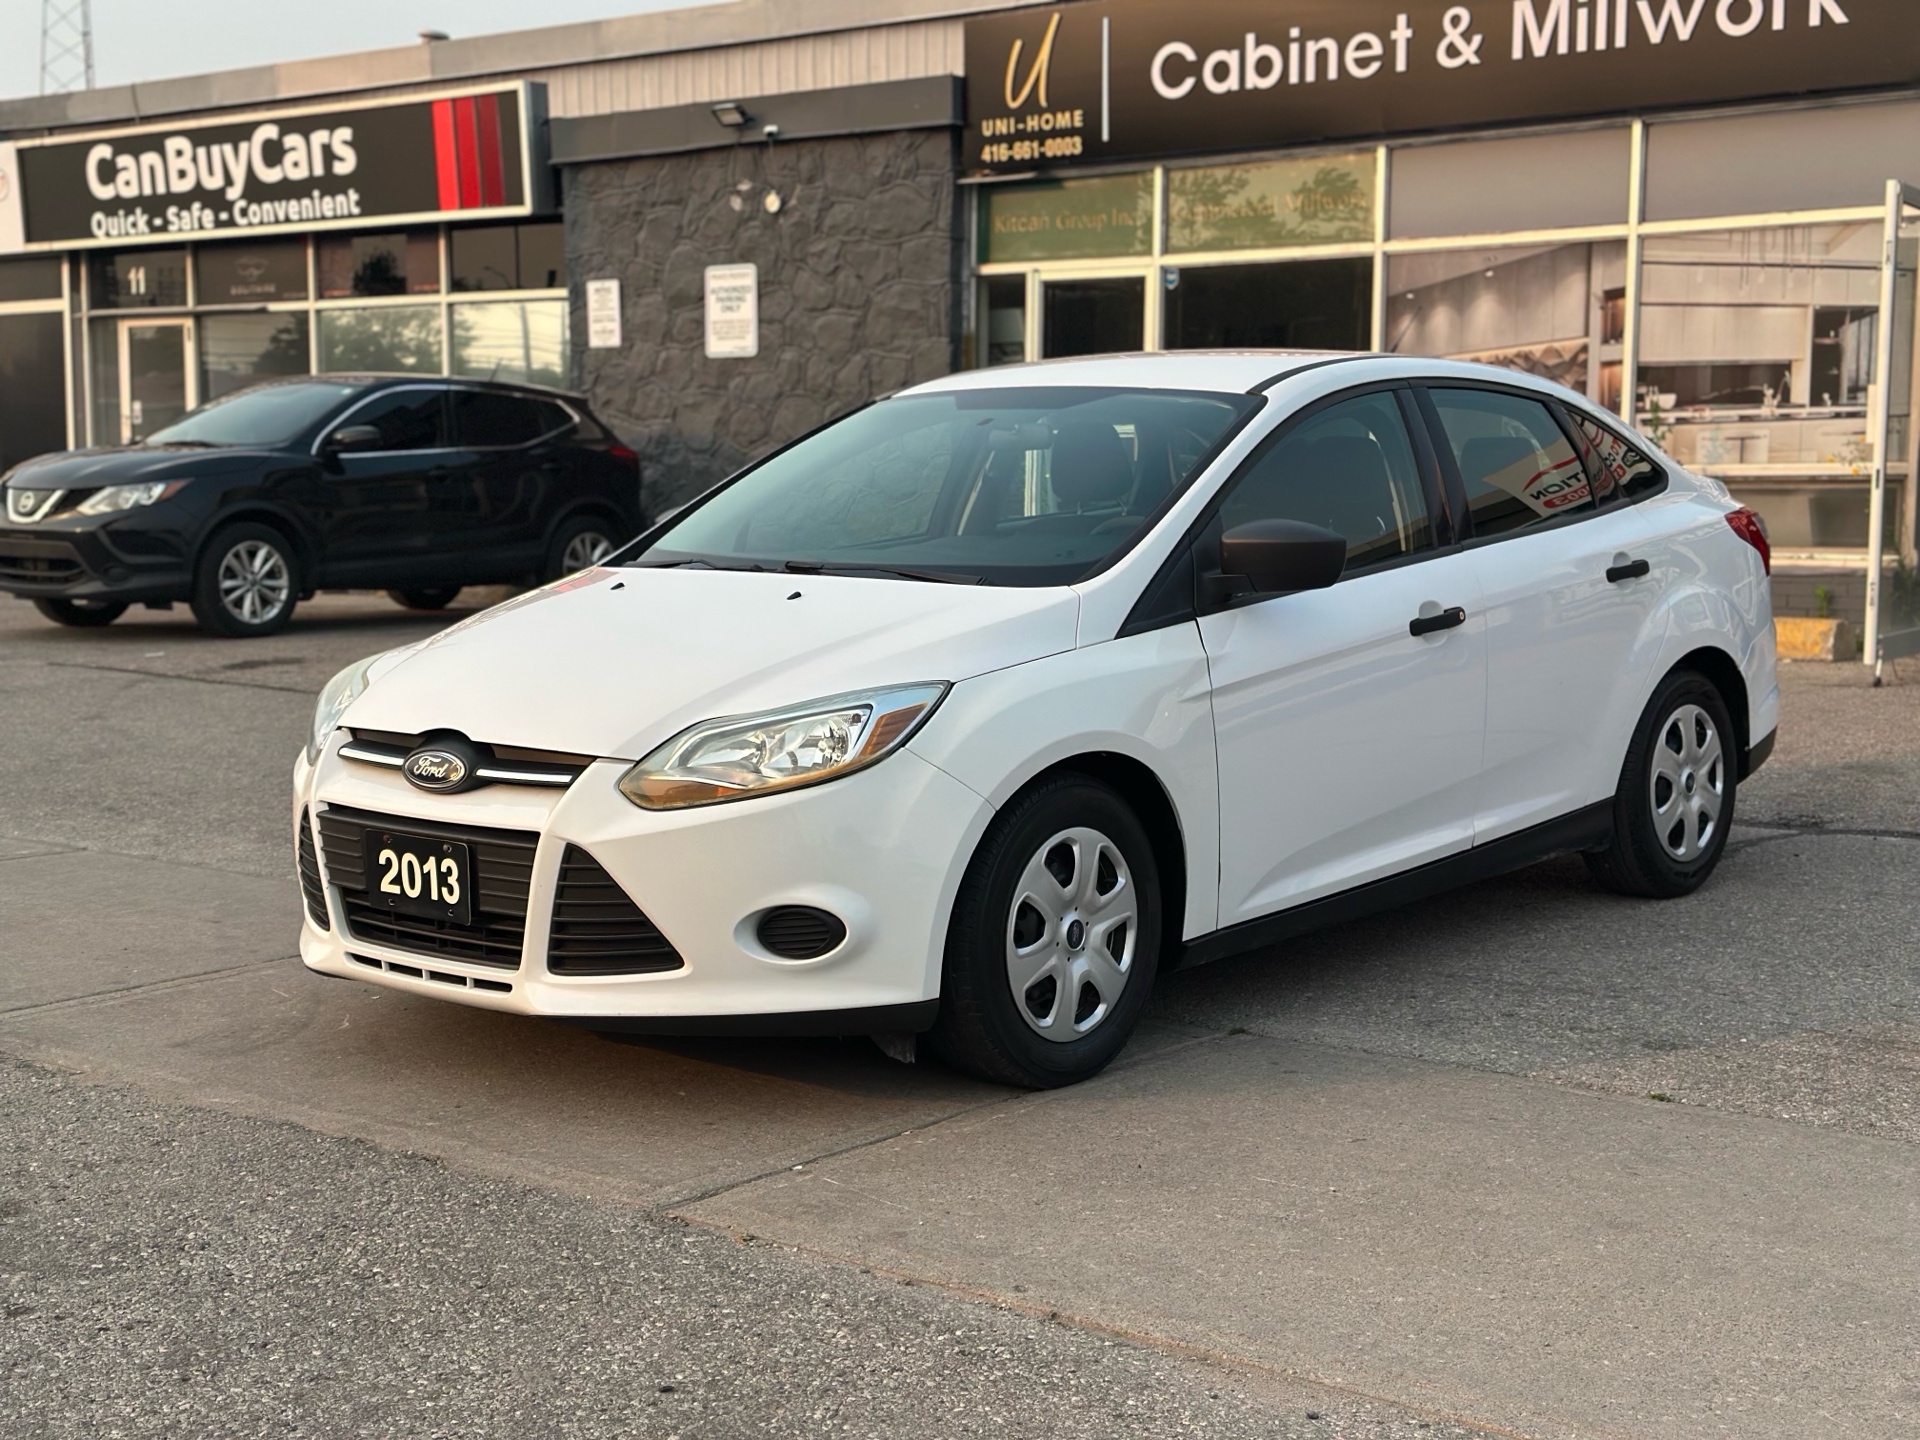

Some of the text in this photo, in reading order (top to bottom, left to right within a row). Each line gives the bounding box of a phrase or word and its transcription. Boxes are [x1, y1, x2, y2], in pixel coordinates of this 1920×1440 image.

[1150, 13, 1414, 100] Cabinet
[1436, 6, 1483, 69] &
[981, 109, 1084, 137] UNI-HOME
[85, 123, 357, 201] CanBuyCars
[981, 135, 1083, 163] 416-661-0003
[90, 207, 150, 239] Quick
[166, 201, 215, 232] Safe
[233, 188, 361, 226] Convenient
[127, 266, 146, 295] 11
[413, 755, 449, 779] Ford
[378, 849, 460, 905] 2013
